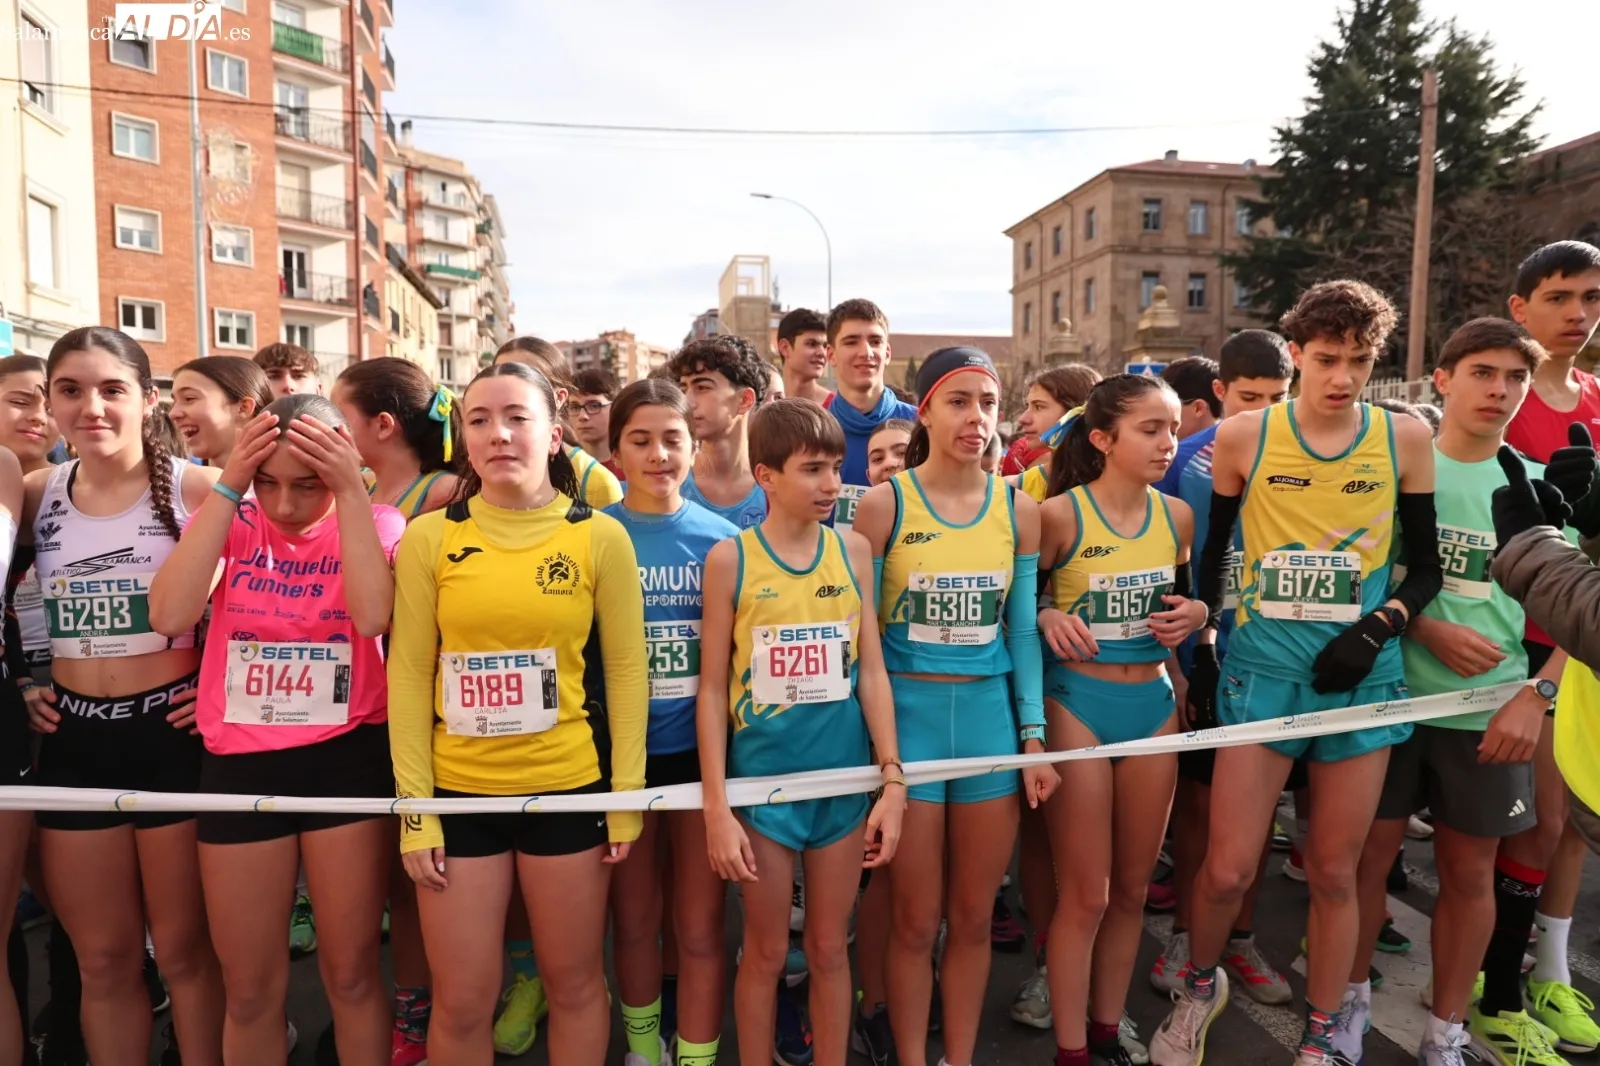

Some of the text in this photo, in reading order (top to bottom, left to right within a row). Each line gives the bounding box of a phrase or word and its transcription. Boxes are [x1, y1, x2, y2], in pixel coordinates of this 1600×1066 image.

[535, 551, 580, 588] Club de Atletismo
[1289, 554, 1352, 568] SETEL
[638, 560, 703, 592] RMUÑ
[936, 576, 998, 589] SETEL
[1116, 571, 1169, 588] SETEL
[1278, 569, 1335, 598] 6173
[69, 579, 148, 595] SETEL
[542, 586, 573, 595] Zamora
[926, 592, 982, 621] 6316
[1107, 587, 1155, 618] 6157
[57, 596, 132, 632] 6293
[79, 630, 109, 638] ANDREA
[780, 626, 843, 642] SETEL
[262, 646, 340, 661] SETEL
[468, 655, 544, 671] SETEL
[769, 644, 828, 678] 6261
[245, 664, 314, 697] 6144
[460, 673, 524, 708] 6189
[787, 676, 814, 684] THIAGO
[60, 694, 135, 720] NIKE
